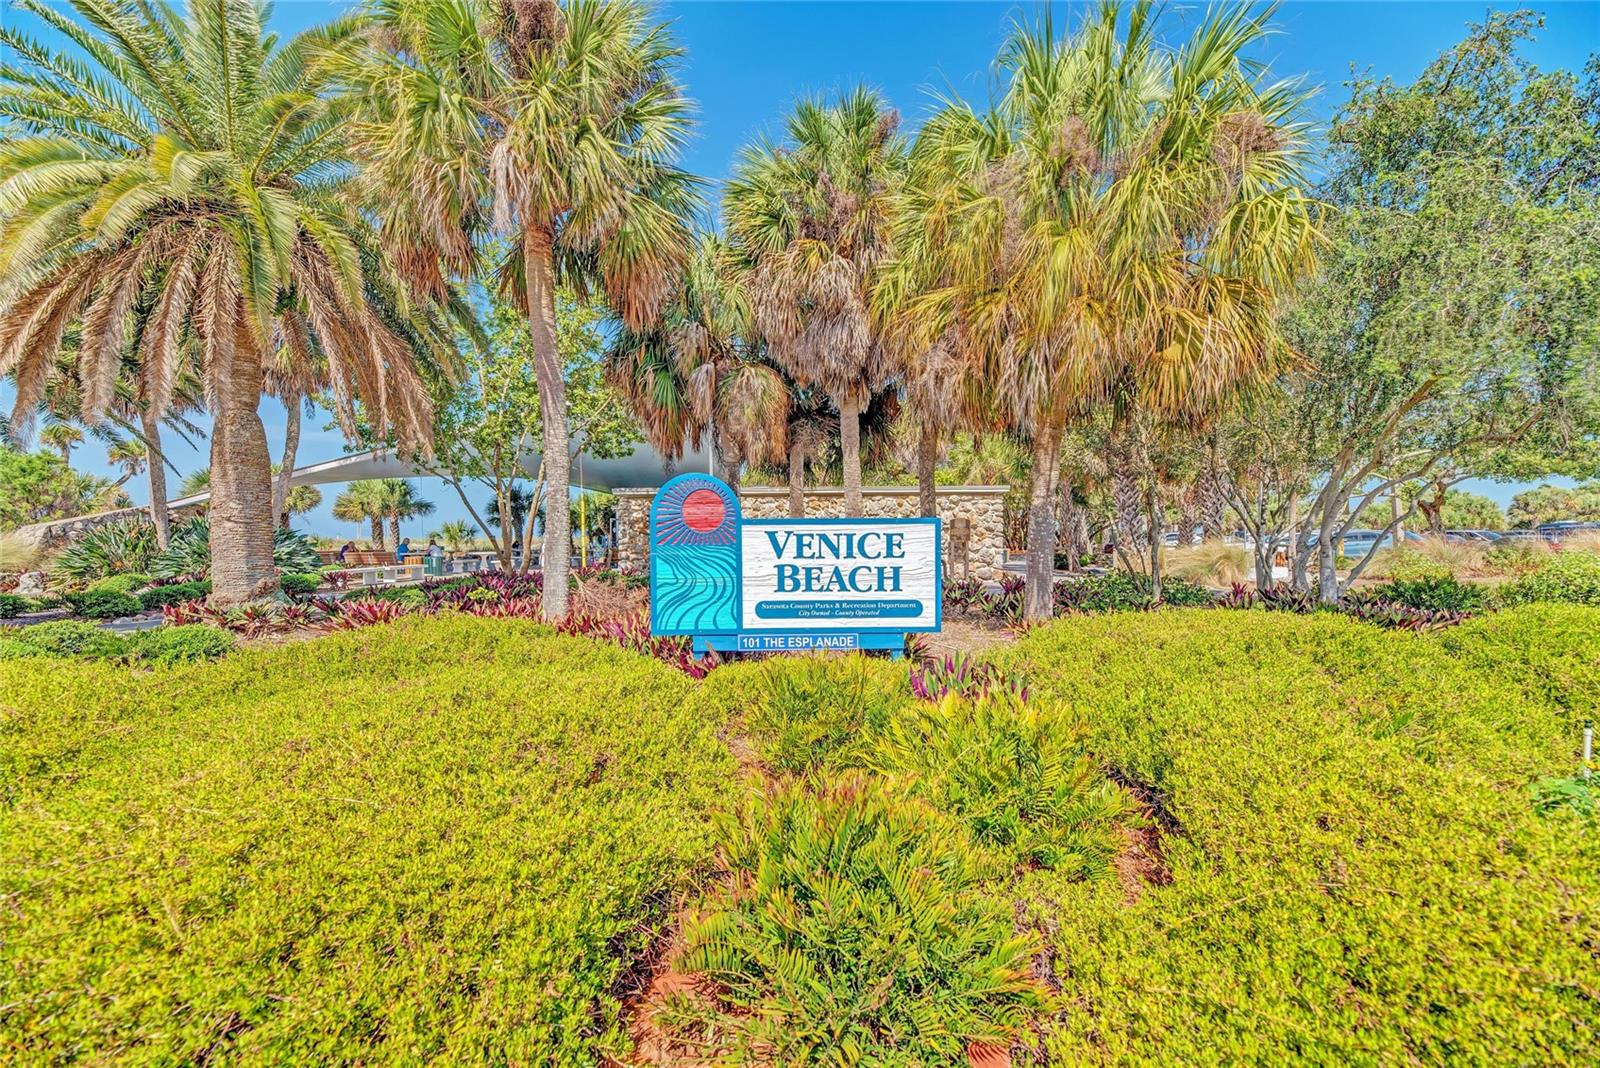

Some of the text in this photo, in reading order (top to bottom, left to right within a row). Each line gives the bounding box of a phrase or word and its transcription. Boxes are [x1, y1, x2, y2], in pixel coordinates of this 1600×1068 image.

[764, 530, 906, 560] VENICE
[773, 564, 903, 593] BEACH
[790, 602, 814, 611] County
[877, 602, 917, 611] Department
[834, 609, 855, 617] County
[855, 609, 880, 617] Operated
[743, 637, 853, 648] 101 THE ESPLANADE
